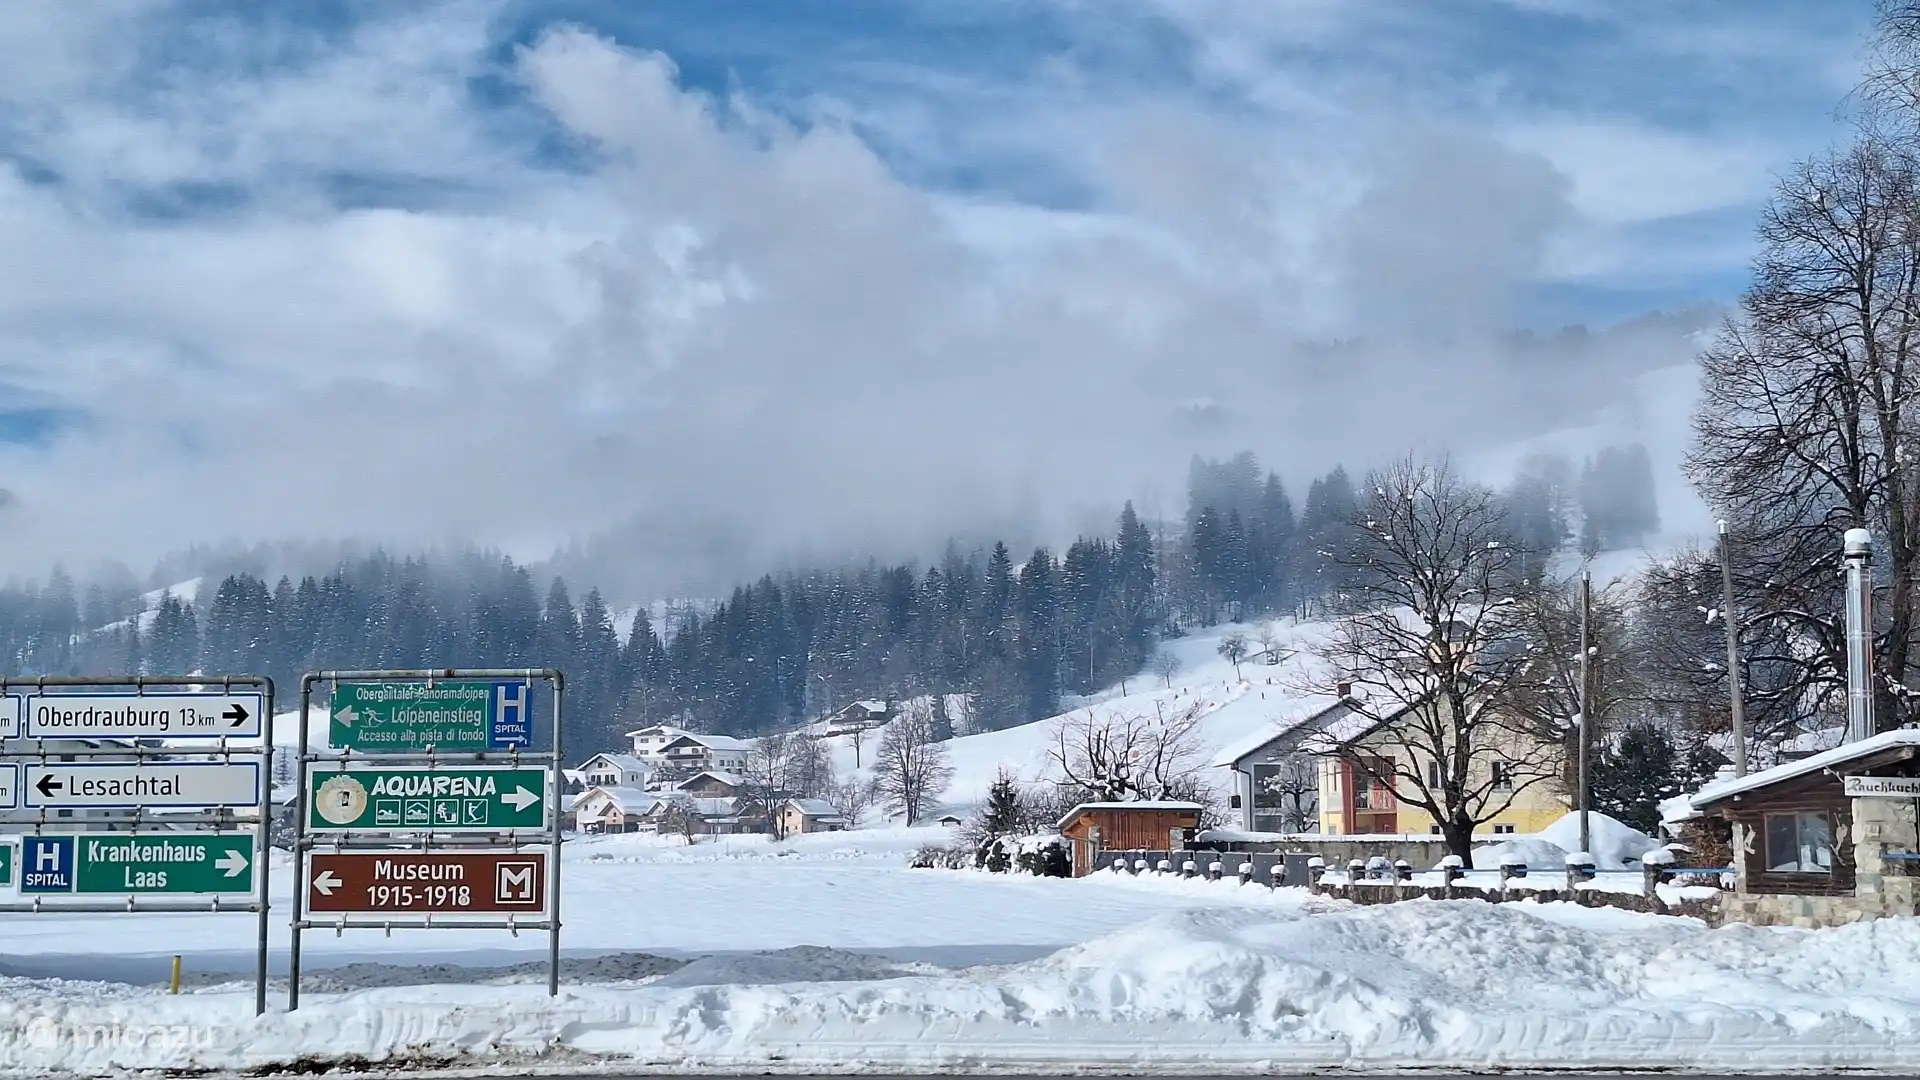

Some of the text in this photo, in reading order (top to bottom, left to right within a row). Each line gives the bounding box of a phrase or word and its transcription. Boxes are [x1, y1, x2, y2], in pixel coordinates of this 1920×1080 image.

[496, 685, 526, 722] H
[37, 706, 215, 731] Oberdrauburg 13 km
[391, 706, 482, 726] Loipeneinstieg
[357, 728, 485, 743] Accesso alla pista di fondo
[494, 724, 526, 733] SPITAL
[69, 775, 181, 797] Lesachtal
[371, 775, 497, 797] AQUARENA
[1847, 778, 1920, 793] Rauchkuch
[36, 842, 60, 871] H
[87, 839, 206, 863] Krankenhaus
[26, 873, 68, 886] SPITAL
[124, 866, 167, 888] Laas
[374, 860, 464, 881] Museum
[366, 885, 471, 906] 1915-1918
